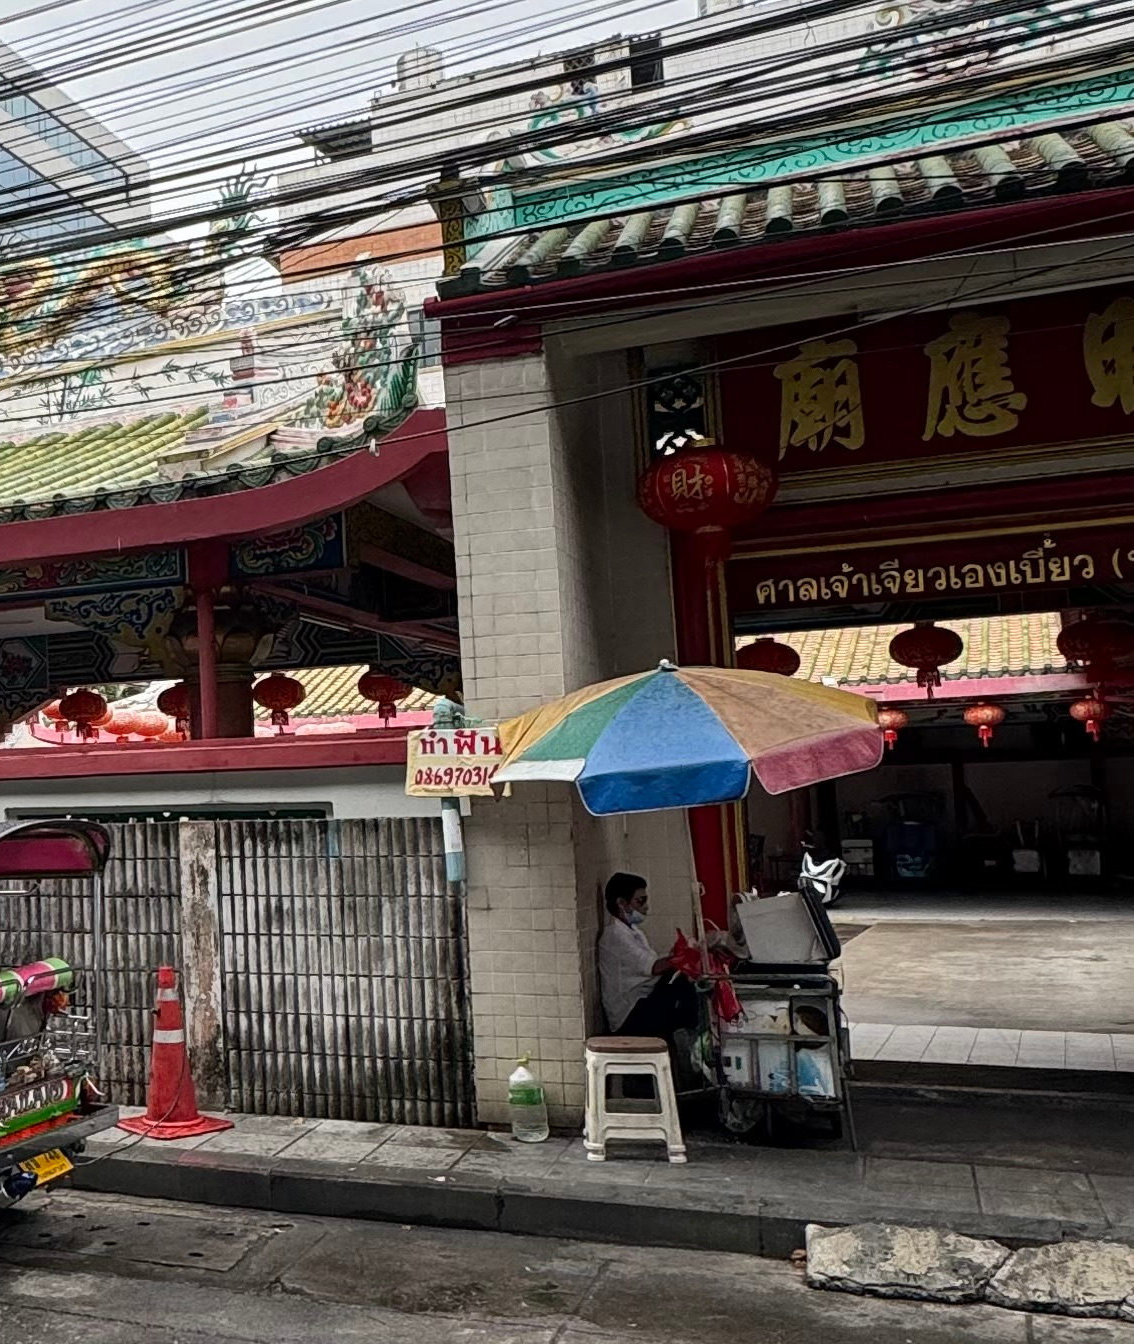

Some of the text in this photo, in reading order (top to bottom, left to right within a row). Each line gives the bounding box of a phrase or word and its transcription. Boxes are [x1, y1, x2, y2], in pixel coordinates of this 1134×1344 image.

[671, 464, 705, 500] 財
[756, 533, 1095, 604] ศาลเจ้าเจียวเองเบี้ยว
